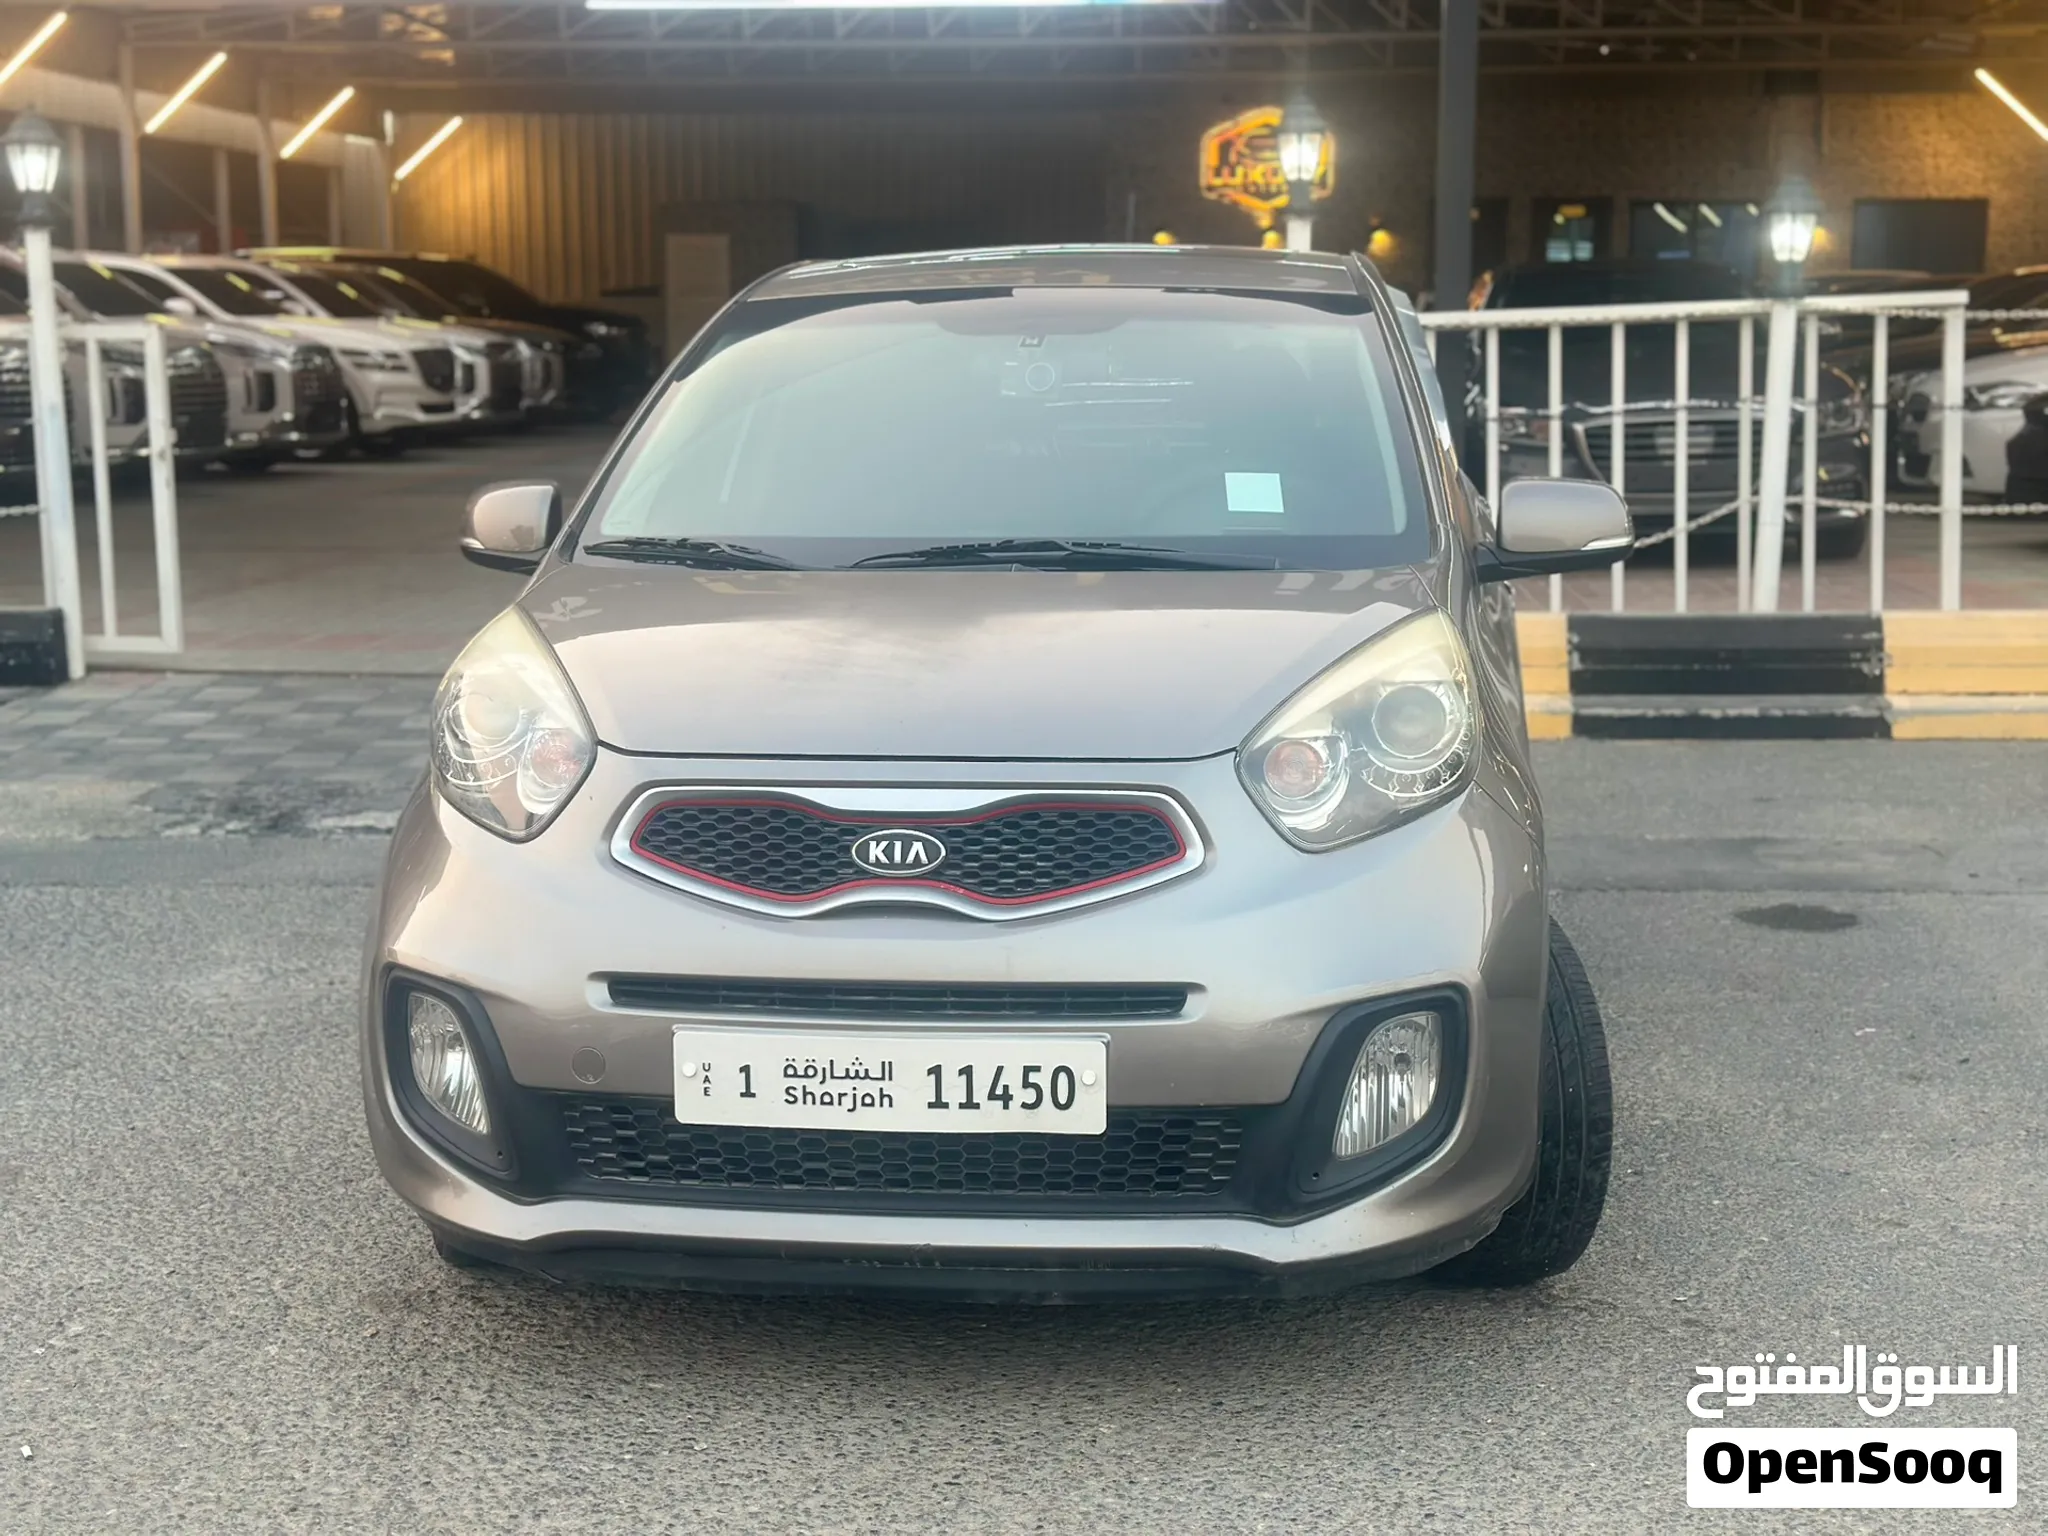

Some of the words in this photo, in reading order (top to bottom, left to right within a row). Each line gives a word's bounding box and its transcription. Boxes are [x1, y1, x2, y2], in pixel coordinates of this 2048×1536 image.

[868, 840, 929, 864] KIA
[702, 1062, 711, 1097] UAE
[738, 1064, 757, 1098] 1
[783, 1056, 893, 1085] الشارقة
[783, 1085, 894, 1113] Sharjah
[926, 1064, 1076, 1111] 11450
